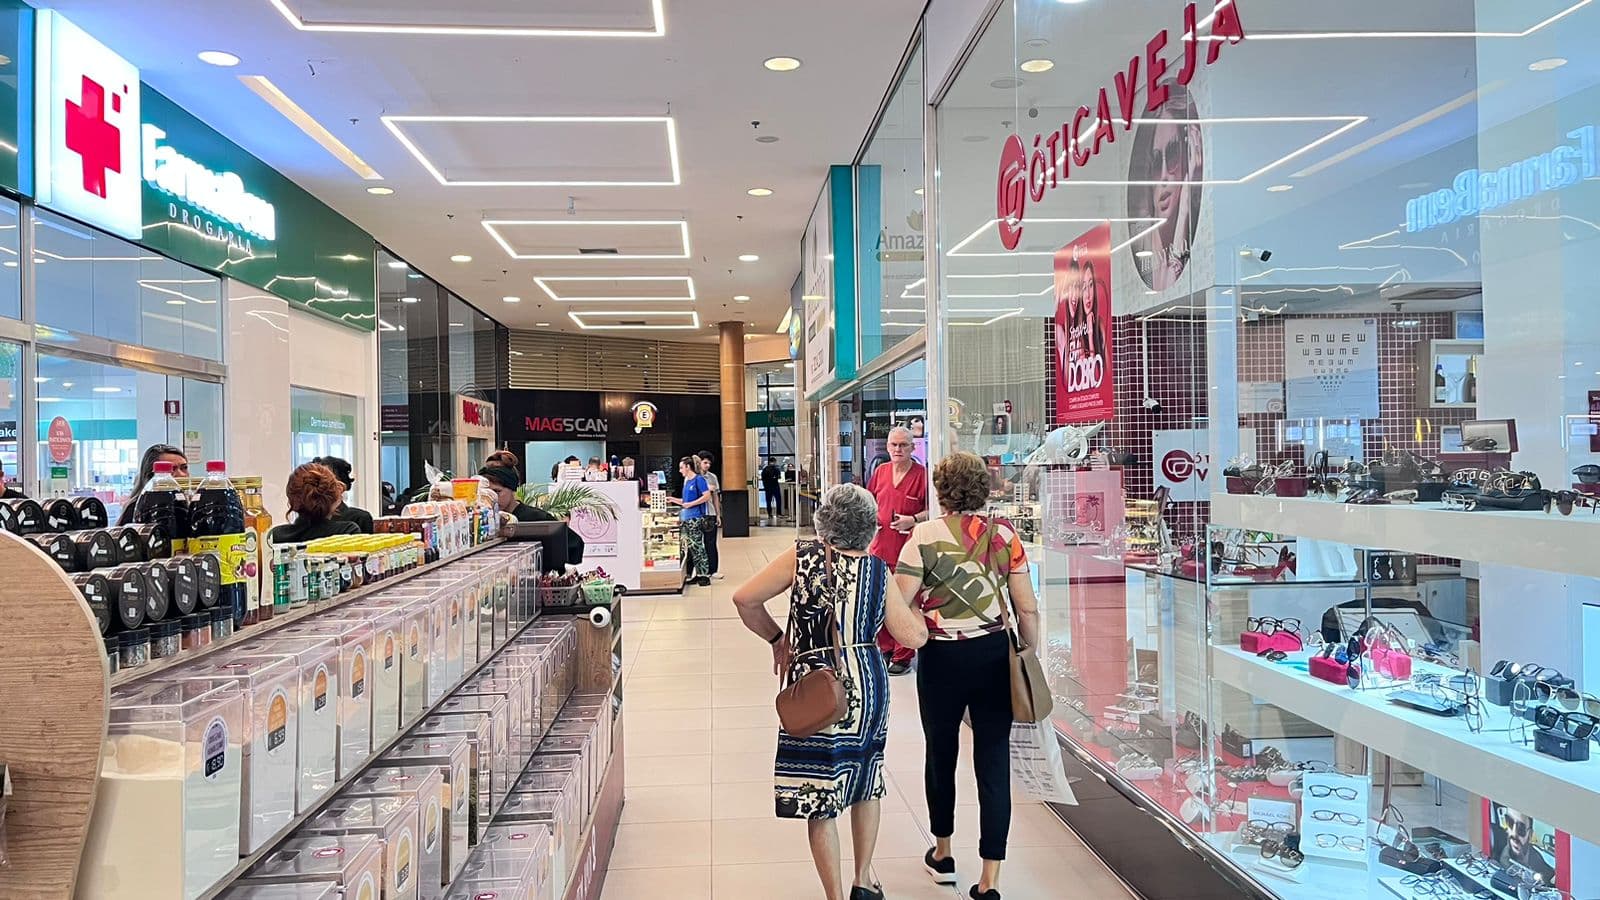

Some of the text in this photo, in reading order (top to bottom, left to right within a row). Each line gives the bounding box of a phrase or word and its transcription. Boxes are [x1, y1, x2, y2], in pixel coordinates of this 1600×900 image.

[169, 202, 252, 254] DROGARIA
[1068, 354, 1104, 393] DOBRO
[525, 417, 608, 432] MAGSCAN
